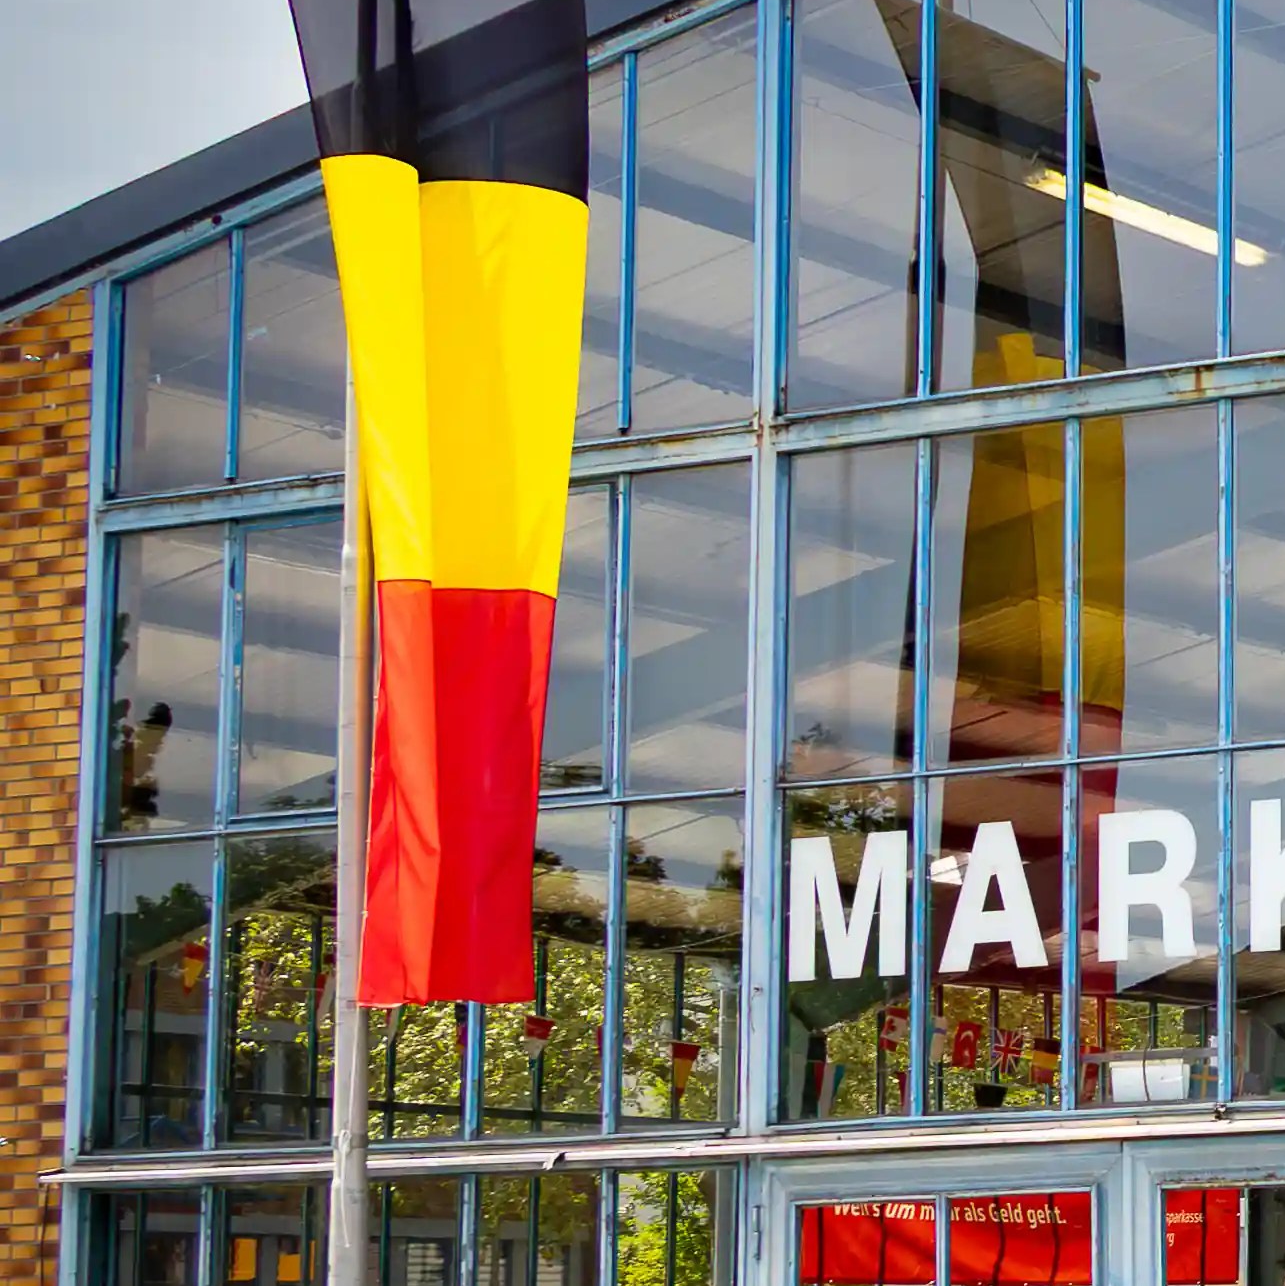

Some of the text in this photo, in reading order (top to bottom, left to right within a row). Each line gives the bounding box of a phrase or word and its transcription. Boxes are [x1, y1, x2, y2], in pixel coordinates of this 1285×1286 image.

[885, 1202, 916, 1220] um
[919, 1207, 960, 1223] mr
[963, 1202, 987, 1222] als
[988, 1202, 1024, 1225] Geld
